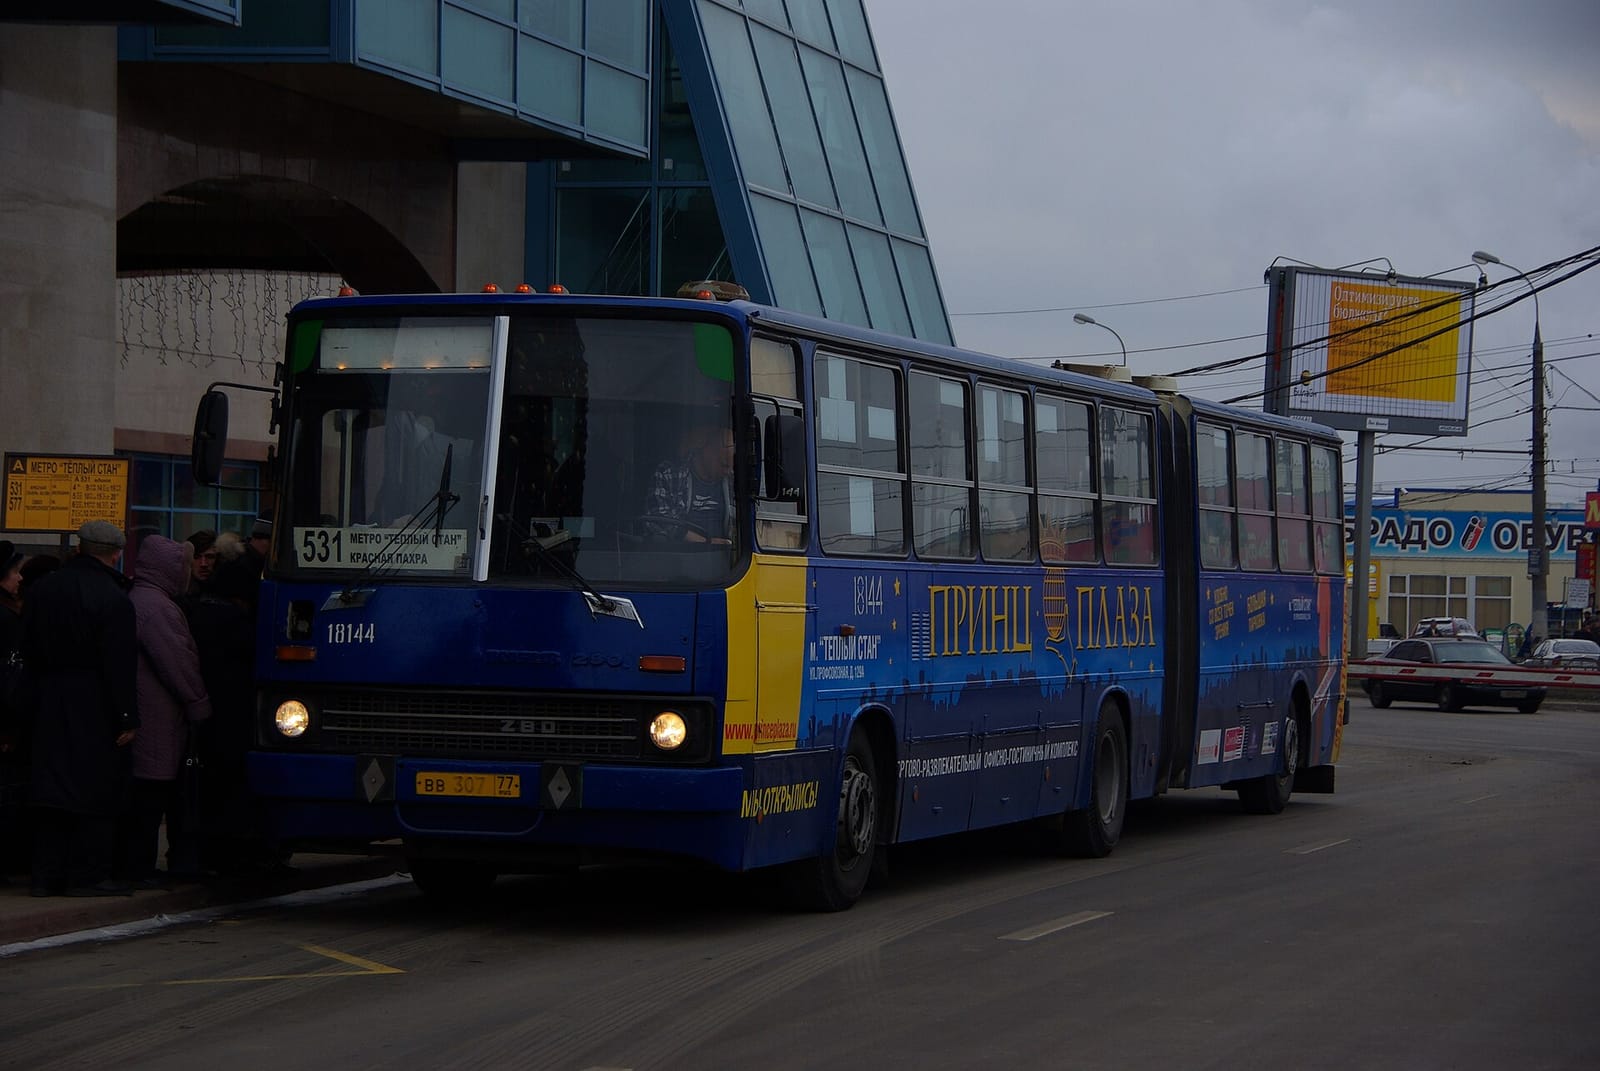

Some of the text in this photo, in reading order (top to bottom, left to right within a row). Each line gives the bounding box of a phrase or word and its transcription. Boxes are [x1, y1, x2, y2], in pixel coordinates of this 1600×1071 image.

[13, 459, 24, 471] А
[31, 461, 58, 473] МЕТРО
[10, 481, 22, 495] 531
[9, 497, 22, 511] 577
[303, 530, 342, 563] 531
[350, 533, 382, 545] МЕТРО
[350, 552, 428, 565] КРАСНАЯ ПАХРА
[854, 576, 883, 616] 18144
[928, 585, 1033, 660] ПРИНЦ
[1075, 584, 1156, 650] ПЛАЗА
[327, 623, 376, 644] 18144
[453, 775, 488, 792] 307
[497, 776, 514, 789] 77
[762, 780, 819, 816] ОТКРЫЛИСЬ!
